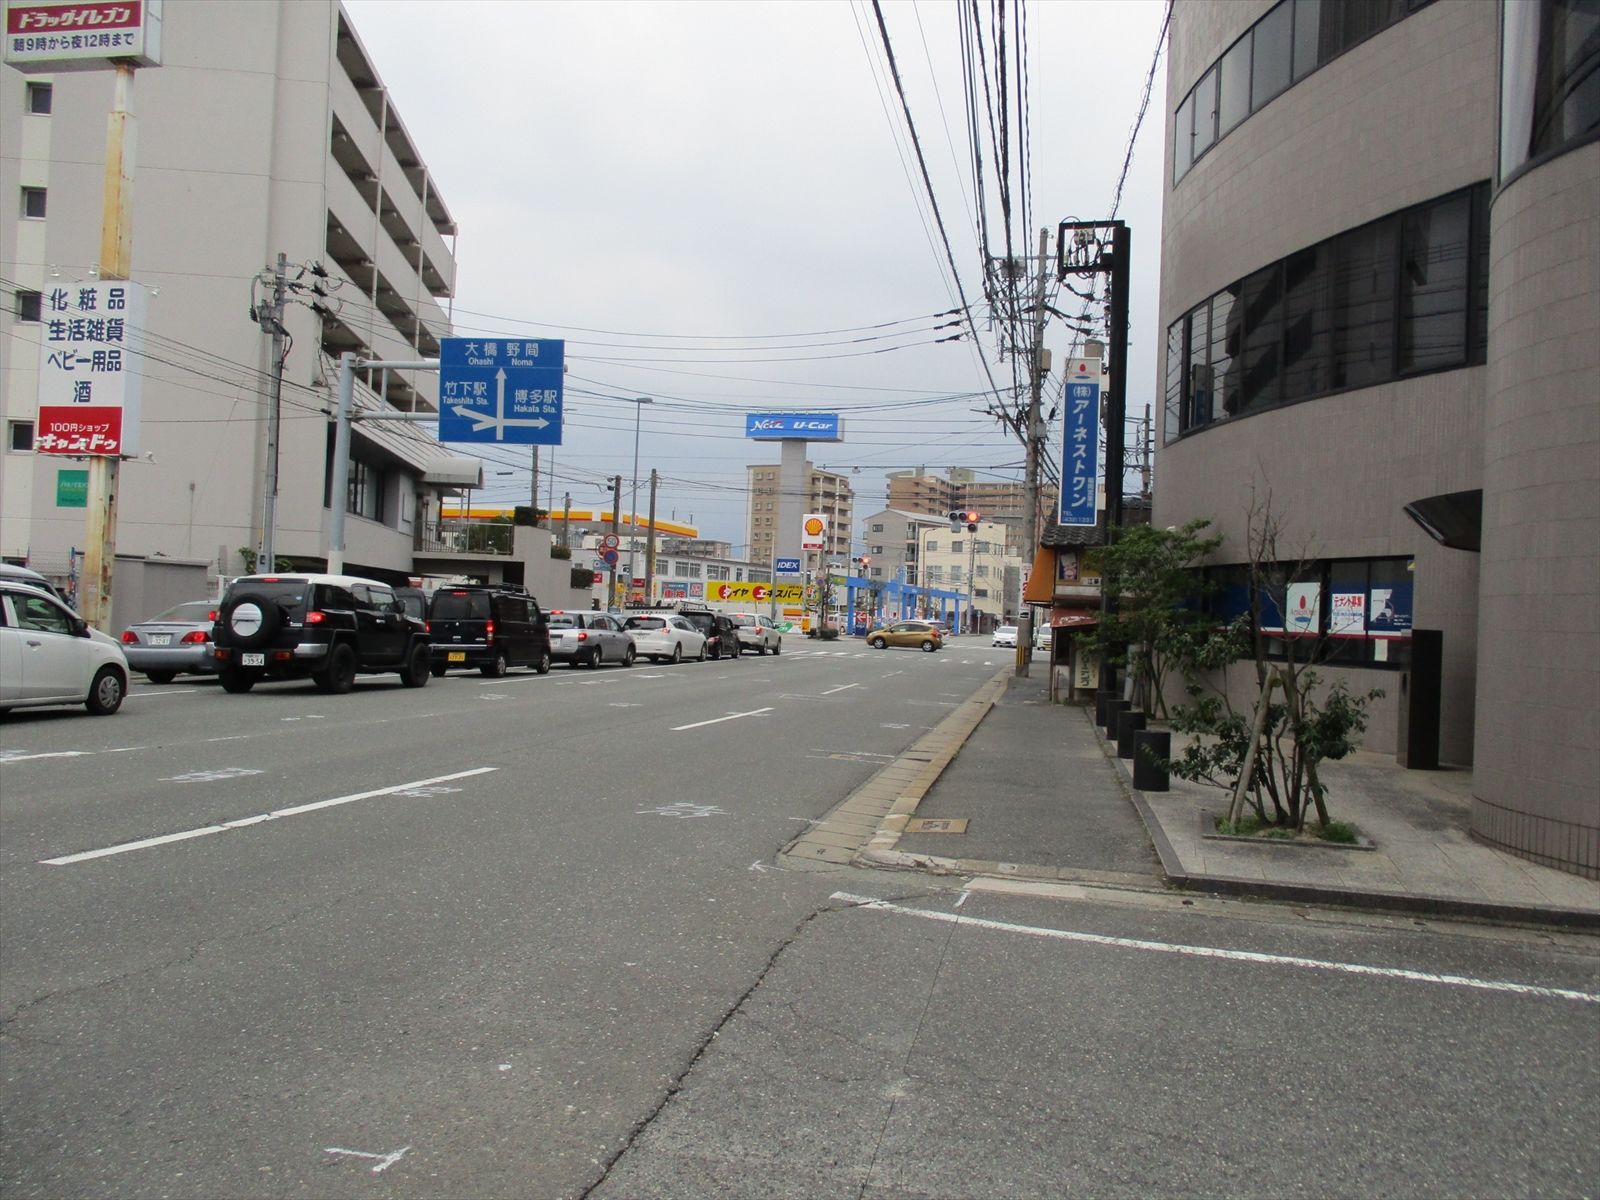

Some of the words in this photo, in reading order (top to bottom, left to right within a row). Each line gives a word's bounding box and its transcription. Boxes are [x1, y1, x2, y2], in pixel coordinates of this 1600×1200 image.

[19, 7, 130, 28] ドラッグイレブン
[13, 33, 134, 52] 朝9時から夜12時まで
[50, 288, 125, 311] 化粧品
[48, 318, 124, 341] 生活雑貨
[465, 342, 497, 356] 大橋
[506, 342, 539, 357] 野間
[47, 349, 122, 372] ベビー用品
[468, 358, 494, 366] Ohashi
[511, 358, 533, 366] Noma
[73, 380, 92, 402] 酒
[444, 381, 488, 395] 竹下駅
[514, 389, 557, 404] 博多駅
[514, 405, 539, 413] Hakata
[50, 423, 110, 432] 100円ショップ
